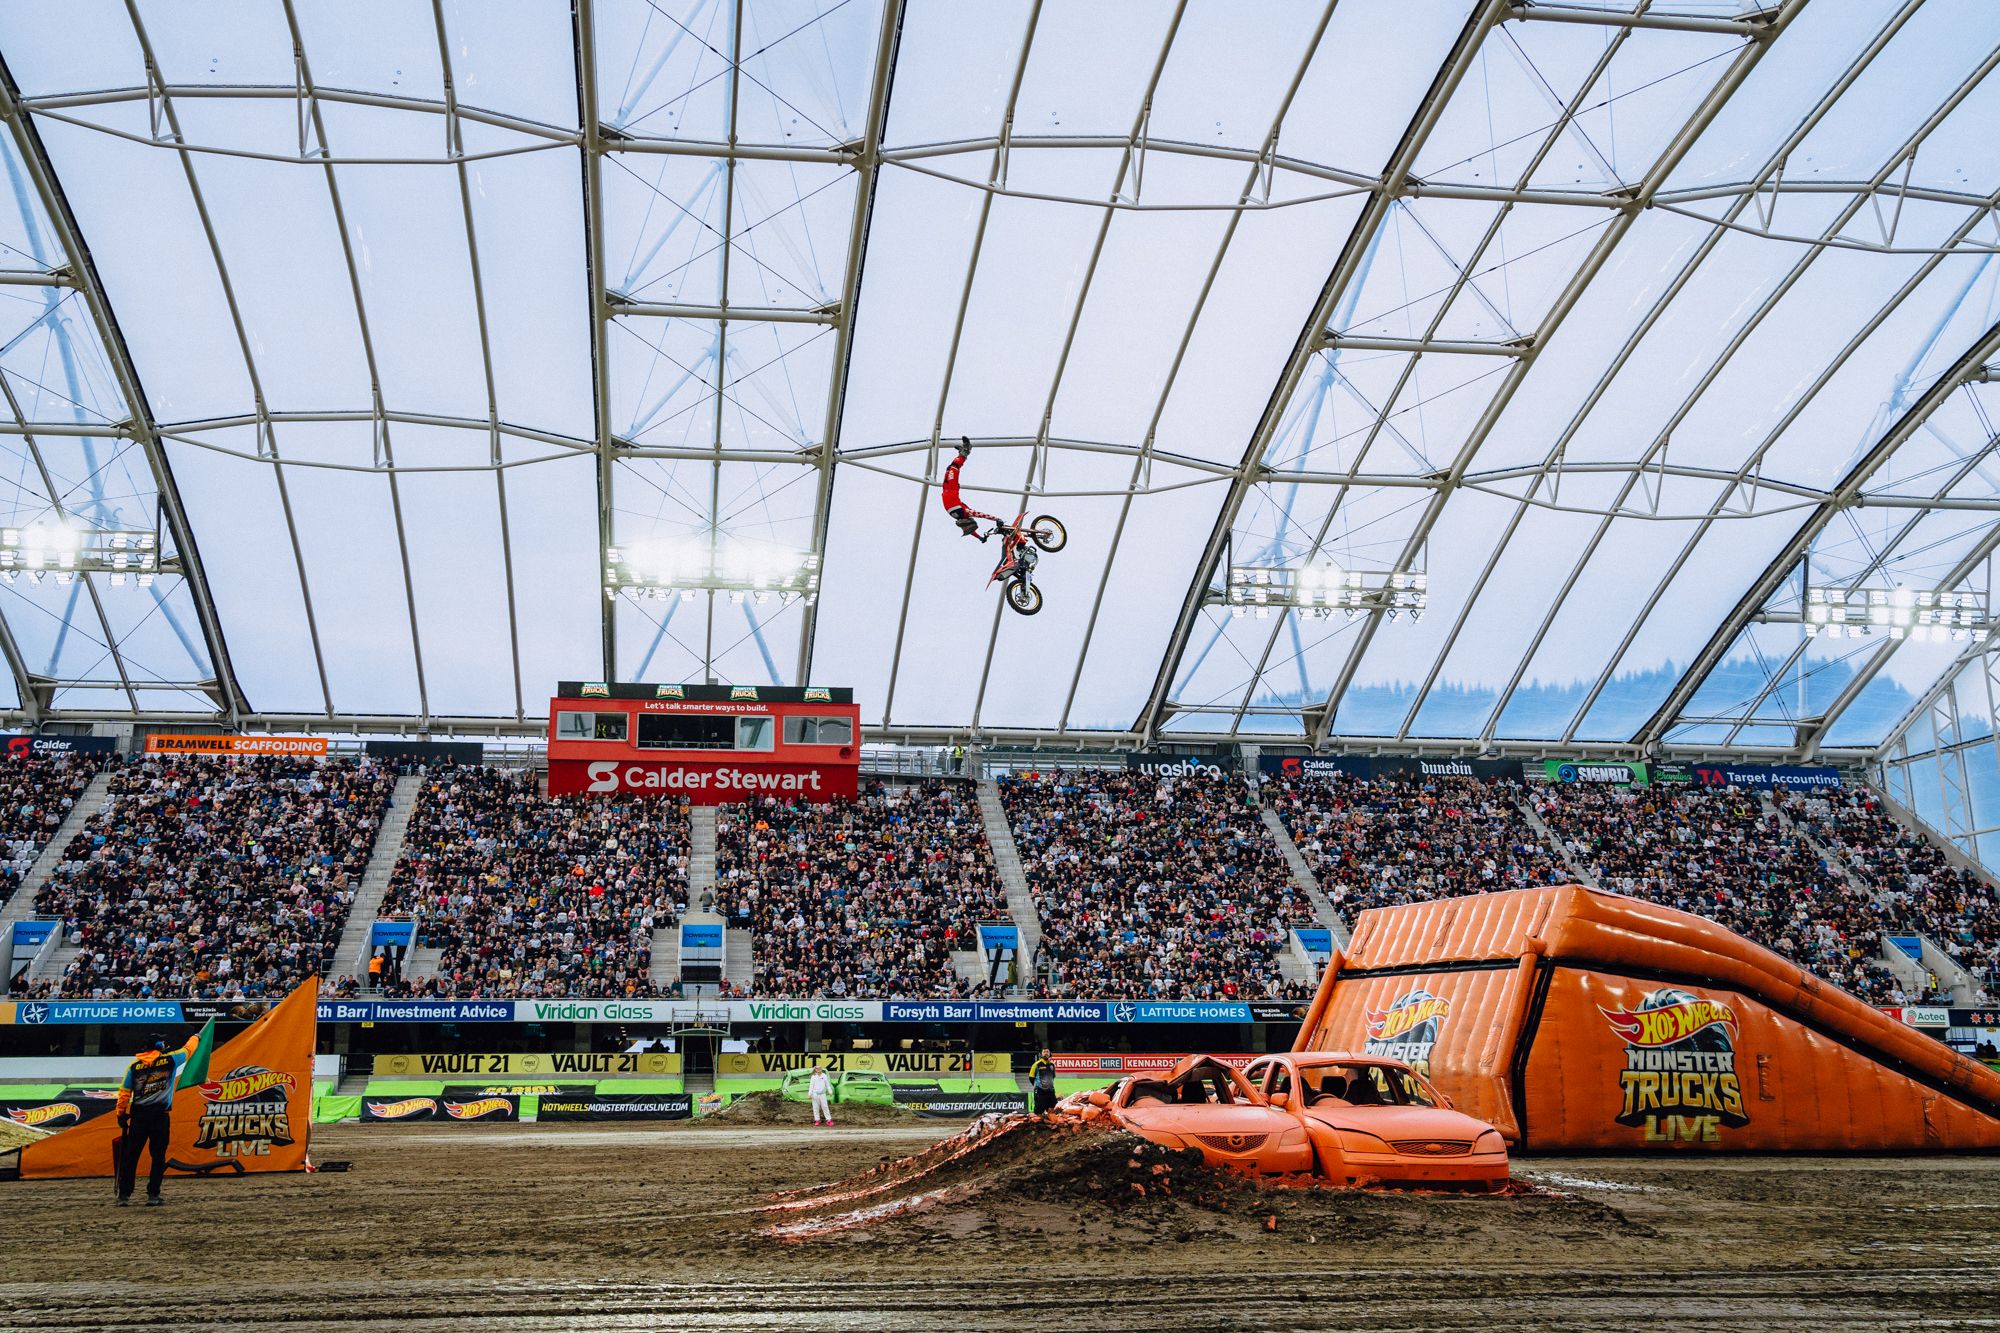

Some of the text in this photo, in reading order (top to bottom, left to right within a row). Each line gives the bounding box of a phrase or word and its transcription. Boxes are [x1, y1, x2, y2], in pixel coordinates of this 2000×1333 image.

[581, 686, 609, 695] TRUCKS
[656, 688, 684, 697] TRUCKS
[730, 690, 758, 699] TRUCKS
[804, 691, 831, 700] TRUCKS
[746, 704, 768, 712] build.
[33, 740, 72, 749] Calder
[156, 739, 232, 749] BRAMWELL
[233, 740, 323, 752] SCAFFOLDING
[1303, 760, 1335, 769] Calder
[1420, 761, 1472, 775] dunedin
[625, 767, 821, 790] Calder Stewart
[1304, 769, 1343, 777] Stewart
[1577, 767, 1630, 782] SIGNBIZ
[1654, 769, 1693, 781] Branding
[1727, 772, 1839, 786] Target Accounting
[54, 1007, 176, 1018] LATITUDE HOMES
[337, 1005, 367, 1018] Barr
[377, 1005, 457, 1018] Investment
[460, 1005, 507, 1018] Advice
[535, 1003, 653, 1019] Viridian Glass
[749, 1003, 864, 1019] Viridian Glass
[890, 1006, 1100, 1020] Forsyth Barr Investment Advice
[1141, 1007, 1246, 1018] LATITUDE HOMES
[1917, 1012, 1945, 1021] Aotea
[421, 1054, 509, 1073] VAULT 21
[551, 1054, 637, 1073] VAULT 21
[760, 1054, 845, 1072] VAULT 21
[884, 1054, 971, 1072] VAULT 21
[1052, 1059, 1120, 1068] KENNARDS HIRE
[1127, 1059, 1174, 1067] KENNARDS
[1624, 1050, 1734, 1072] MONSTER
[1620, 1071, 1747, 1119] TRUCKS
[206, 1101, 287, 1116] MONSTER
[541, 1102, 688, 1111] HOTWHEELSMONSTERTRUCKSLIVE.COM
[905, 1101, 1025, 1111] HEELSMONSTERTRUCKSLIVE.COM
[197, 1113, 291, 1144] TRUCKS
[1646, 1114, 1721, 1142] LIVE
[216, 1139, 271, 1156] LIVE
